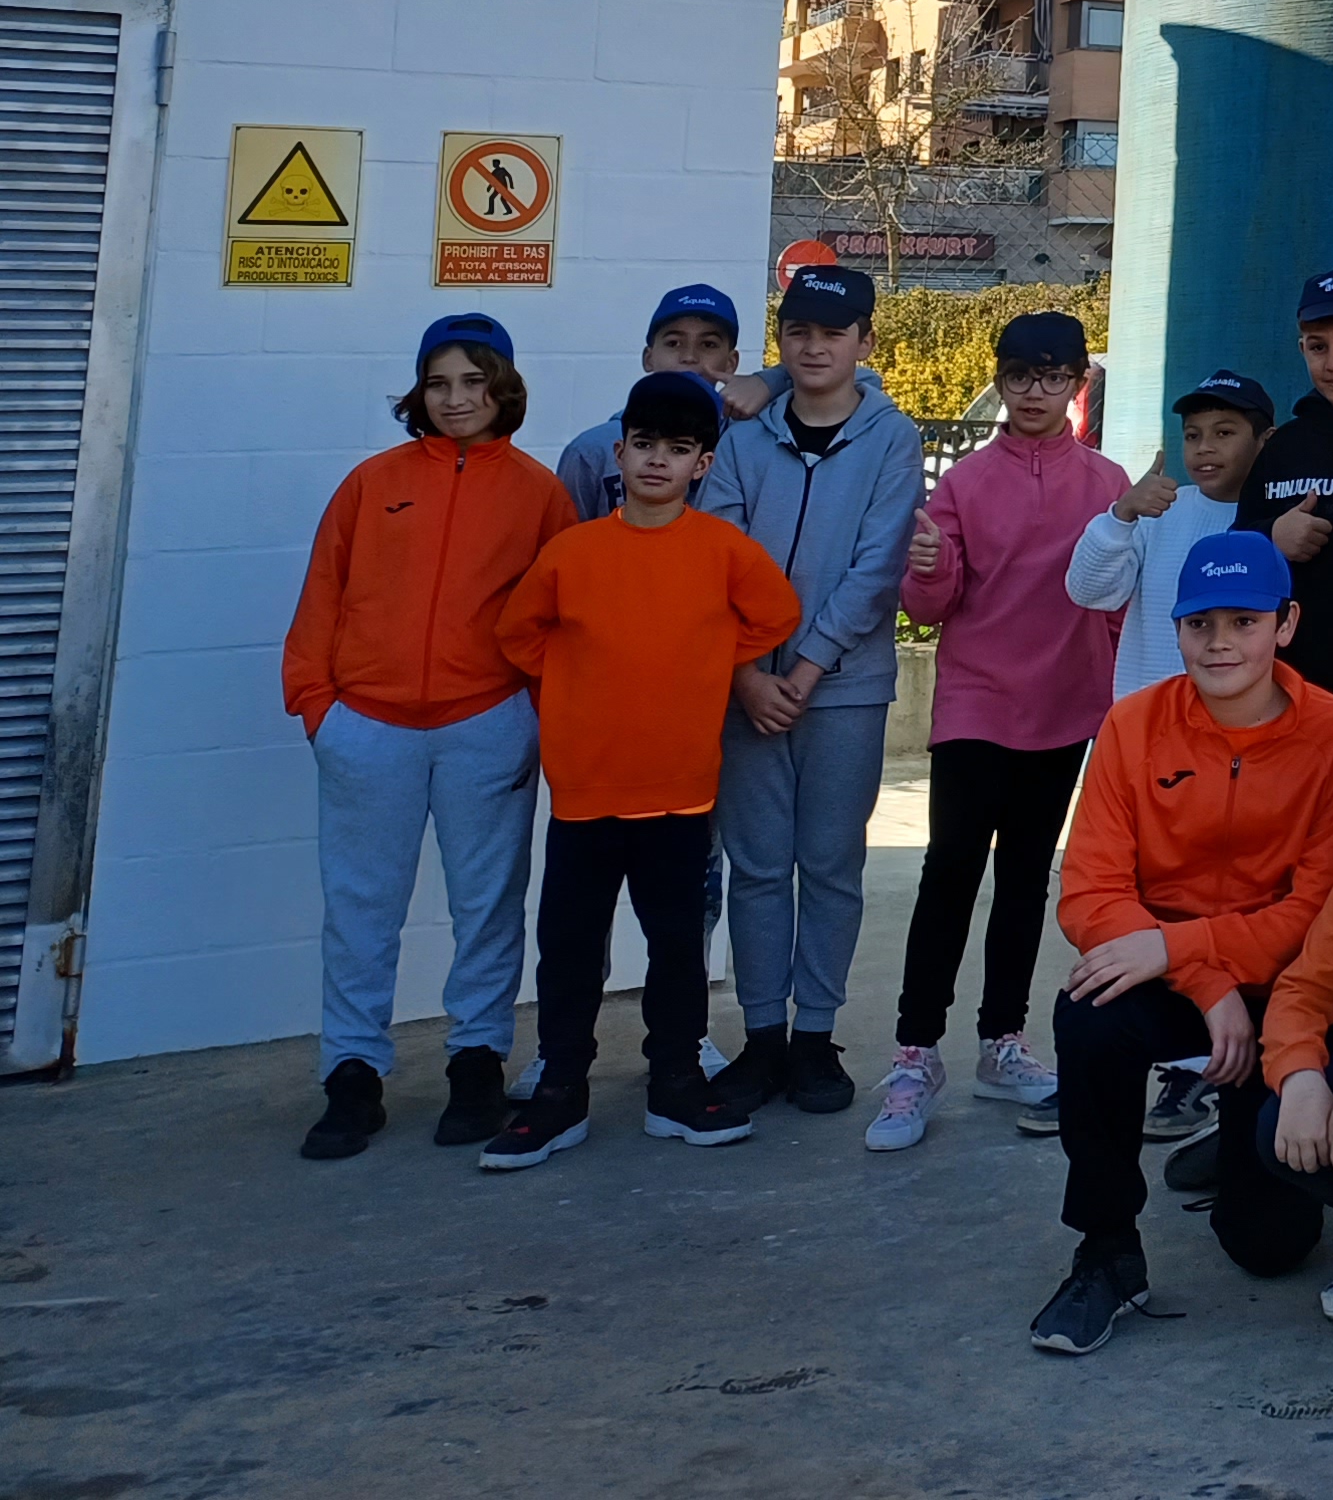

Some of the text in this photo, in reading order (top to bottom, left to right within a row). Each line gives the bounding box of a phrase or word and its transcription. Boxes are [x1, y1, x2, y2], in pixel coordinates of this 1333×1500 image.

[254, 245, 327, 257] ATENCIÓ!
[444, 246, 546, 259] PROHIBIT EL PAS
[238, 257, 262, 269] RISC
[446, 261, 543, 270] A TOTA PERSONA
[236, 271, 298, 281] PRODUCTES
[443, 272, 545, 281] ALIENA AL SERVEI
[805, 279, 847, 296] aqualia
[1206, 562, 1248, 577] aqualia
